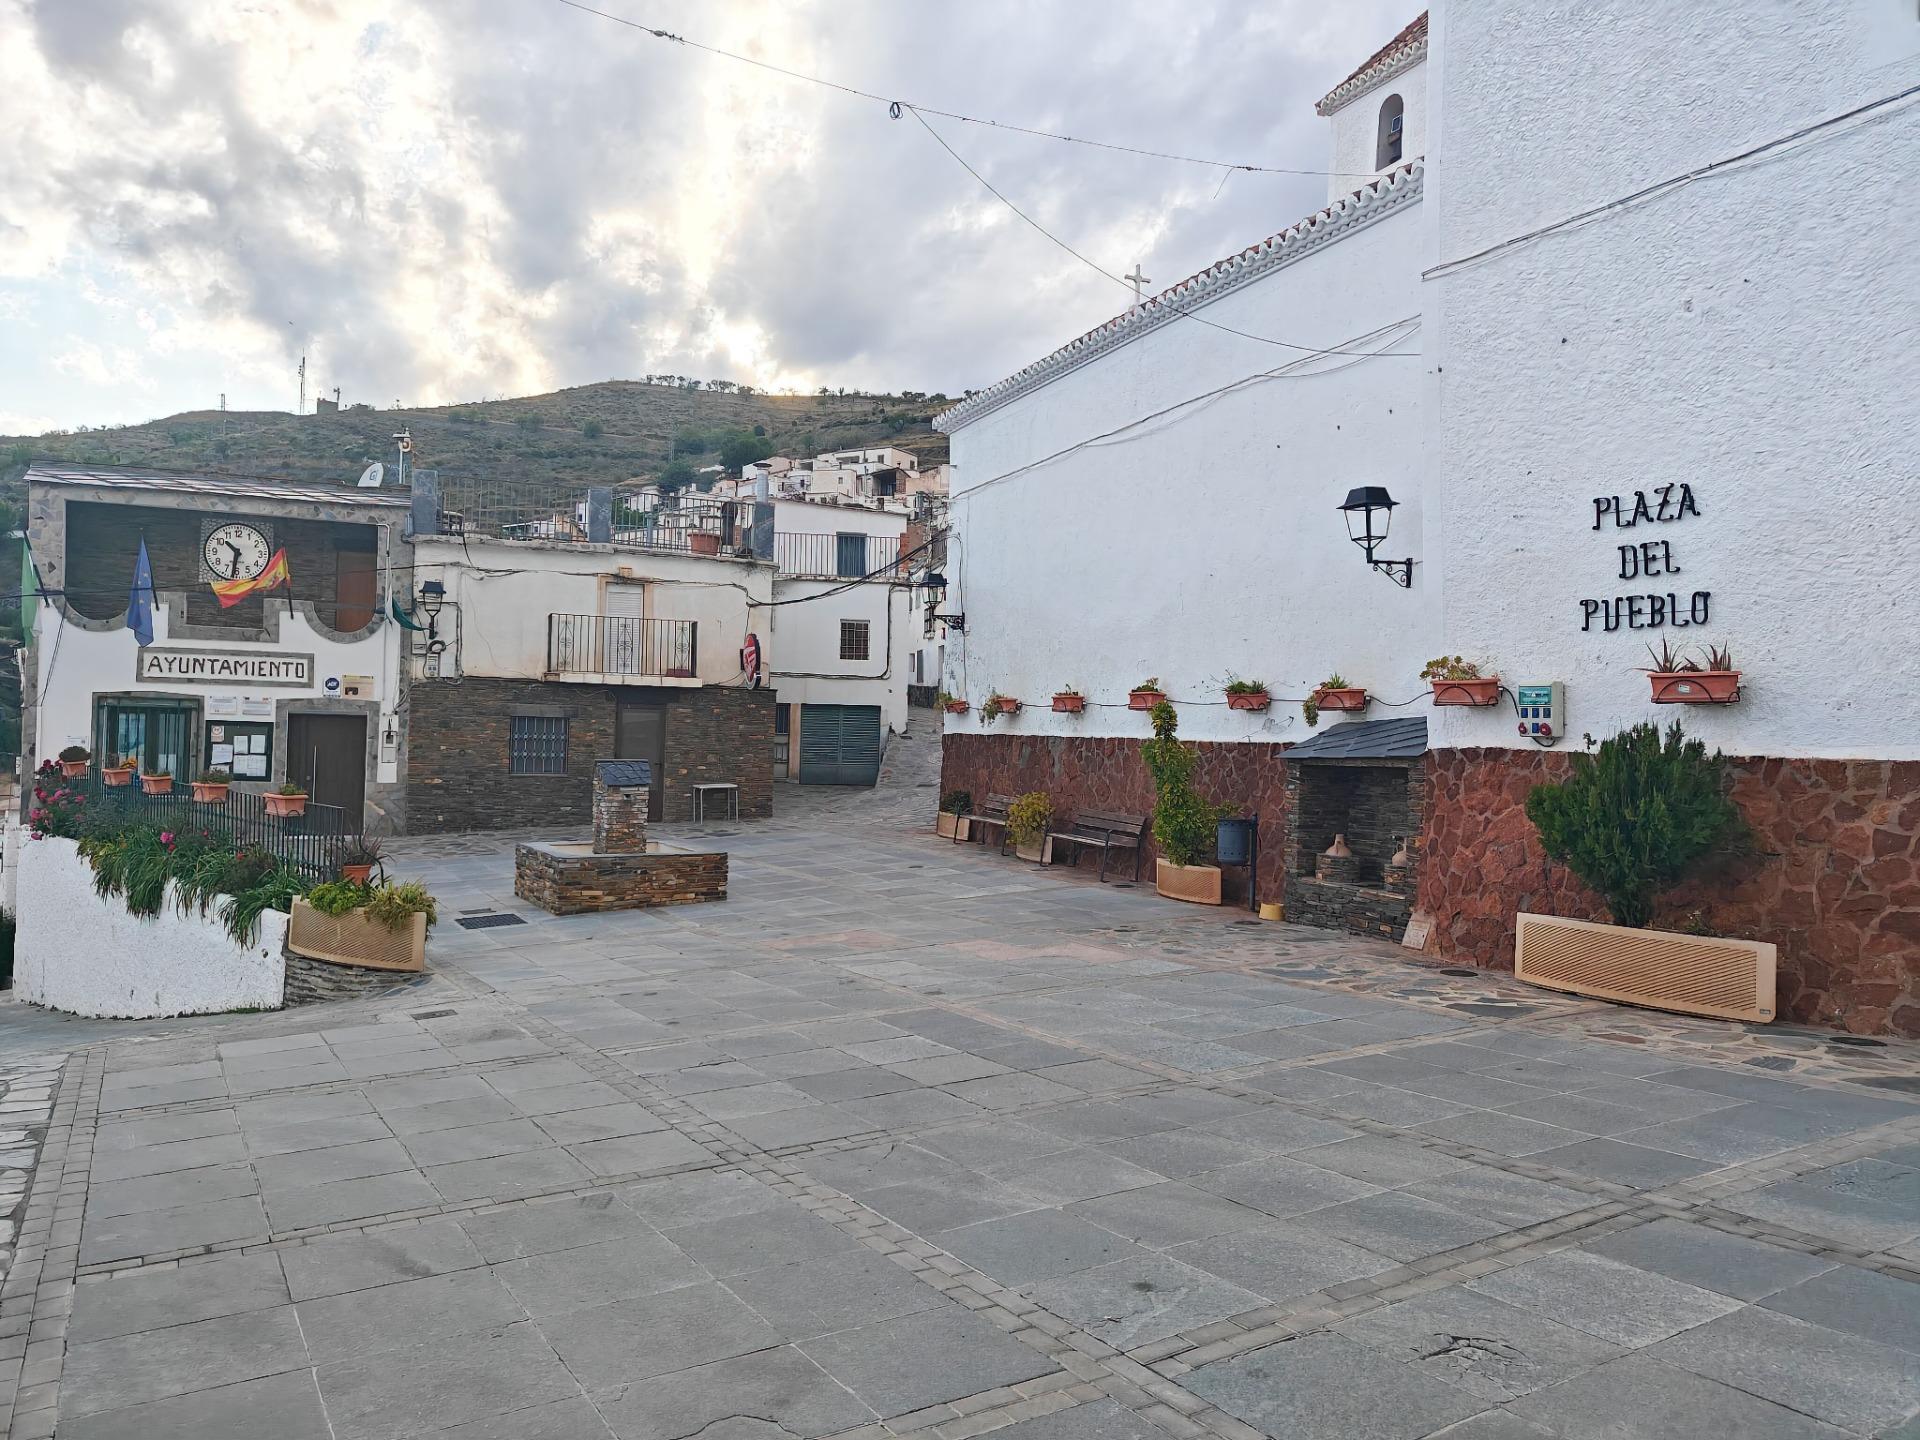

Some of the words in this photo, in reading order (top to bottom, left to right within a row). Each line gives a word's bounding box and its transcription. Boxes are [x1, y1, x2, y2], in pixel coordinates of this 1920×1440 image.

[1592, 483, 1701, 530] PLAZA
[225, 531, 232, 539] 11
[234, 530, 243, 538] 12
[216, 538, 224, 546] 10
[254, 540, 260, 548] 2
[212, 547, 218, 556] 9
[257, 550, 263, 558] 3
[215, 557, 221, 565] 8
[1617, 540, 1681, 579] DEL
[224, 564, 230, 572] 7
[233, 567, 240, 576] 6
[1579, 591, 1711, 631] PUEBLO
[147, 655, 305, 679] AYUNTAMIENTO
